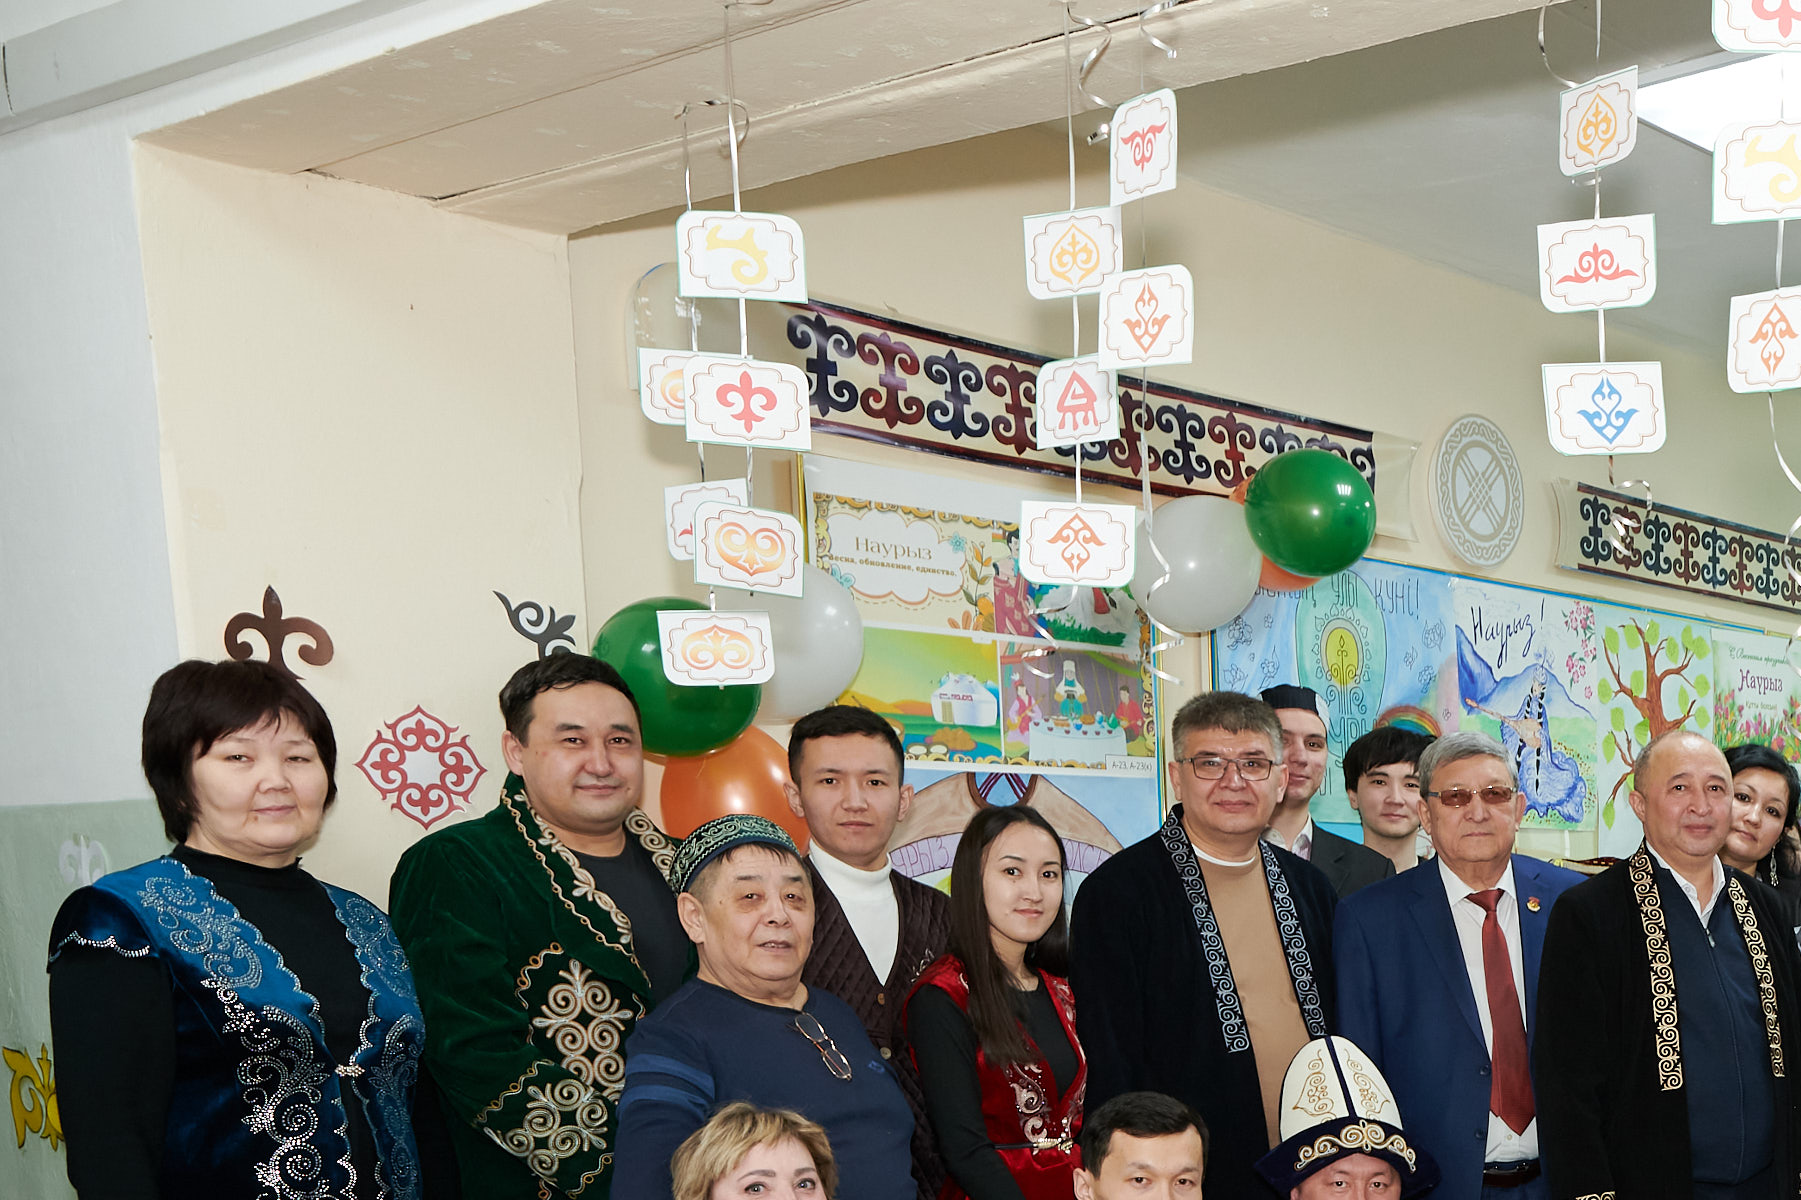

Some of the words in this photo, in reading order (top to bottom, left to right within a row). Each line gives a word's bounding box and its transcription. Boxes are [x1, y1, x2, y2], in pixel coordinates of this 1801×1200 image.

[855, 536, 933, 561] Наурыз
[859, 558, 914, 573] обновление,
[915, 565, 957, 578] единство.
[1737, 668, 1783, 696] Наурыз
